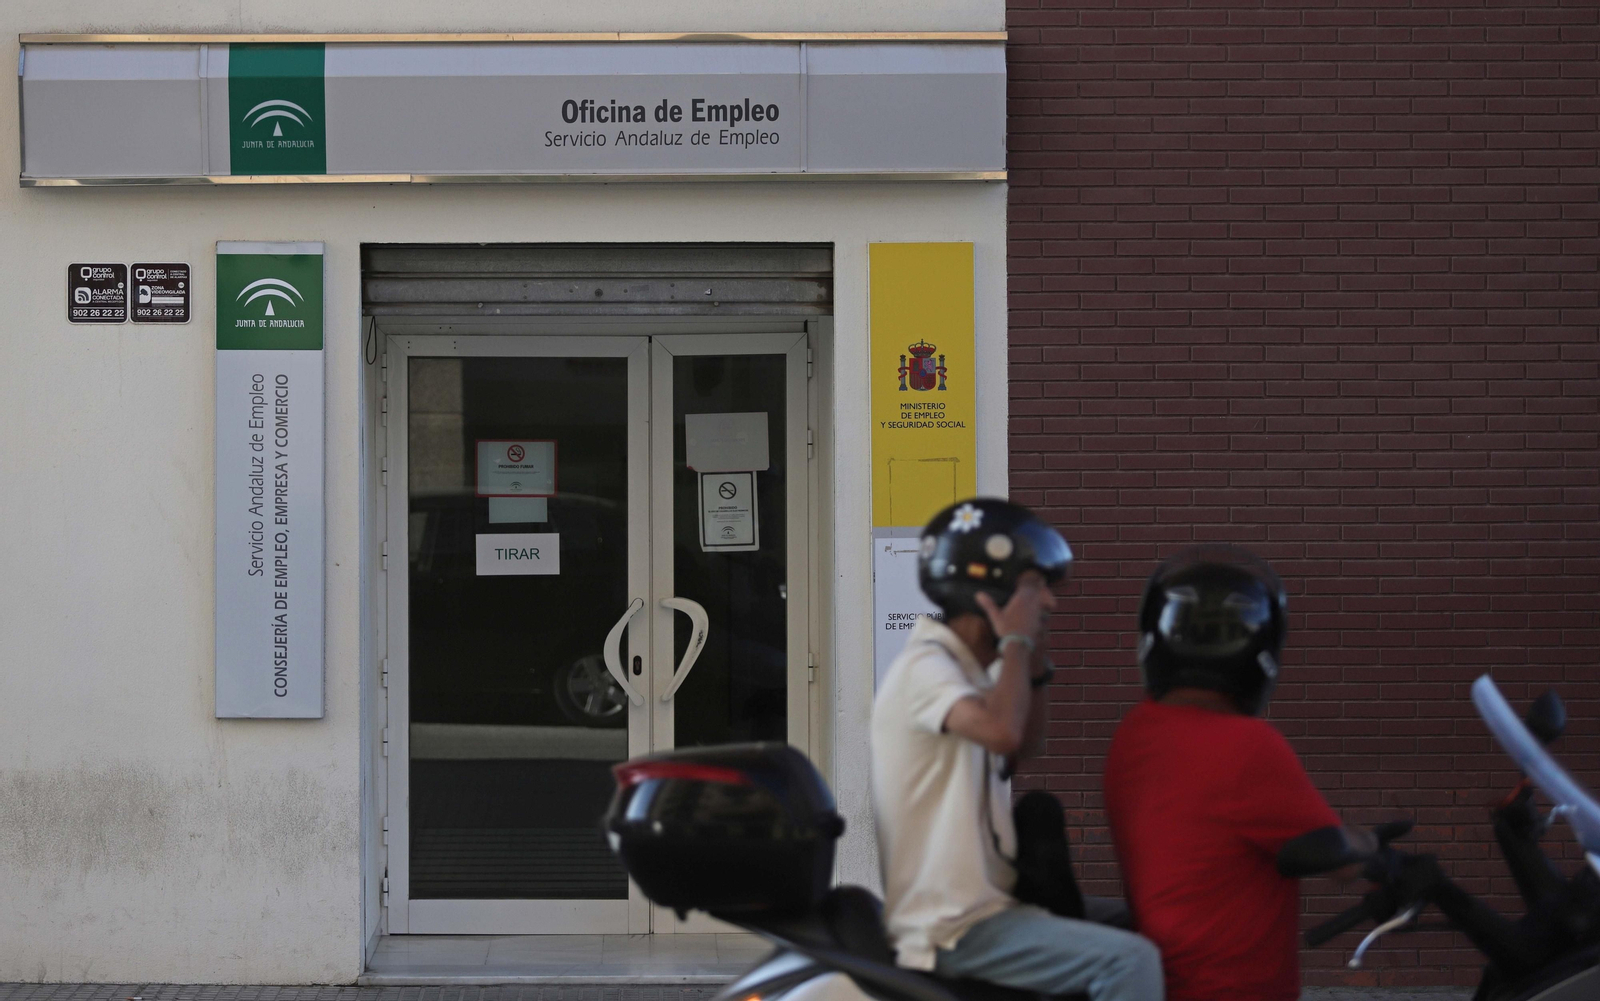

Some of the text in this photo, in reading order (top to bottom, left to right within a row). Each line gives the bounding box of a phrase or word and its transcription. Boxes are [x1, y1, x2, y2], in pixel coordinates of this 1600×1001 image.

[561, 98, 780, 127] Oficina de Empleo
[544, 129, 780, 149] Servicio Andaluz de Empleo
[242, 140, 315, 149] JUNTA DE ANDALUCIA
[73, 309, 125, 317] 902 26 22 22
[235, 319, 305, 328] JUNTA DE ANDALUCIA
[900, 402, 946, 410] MINISTERIO
[880, 421, 886, 429] Y
[888, 421, 934, 429] SEGURIDAD
[248, 373, 268, 577] Servicio Andaluz de Empleo
[271, 374, 290, 697] CONSEJERÍA DE EMPLEO, EMPRESA Y COMERCIO
[494, 548, 540, 560] TIRAR
